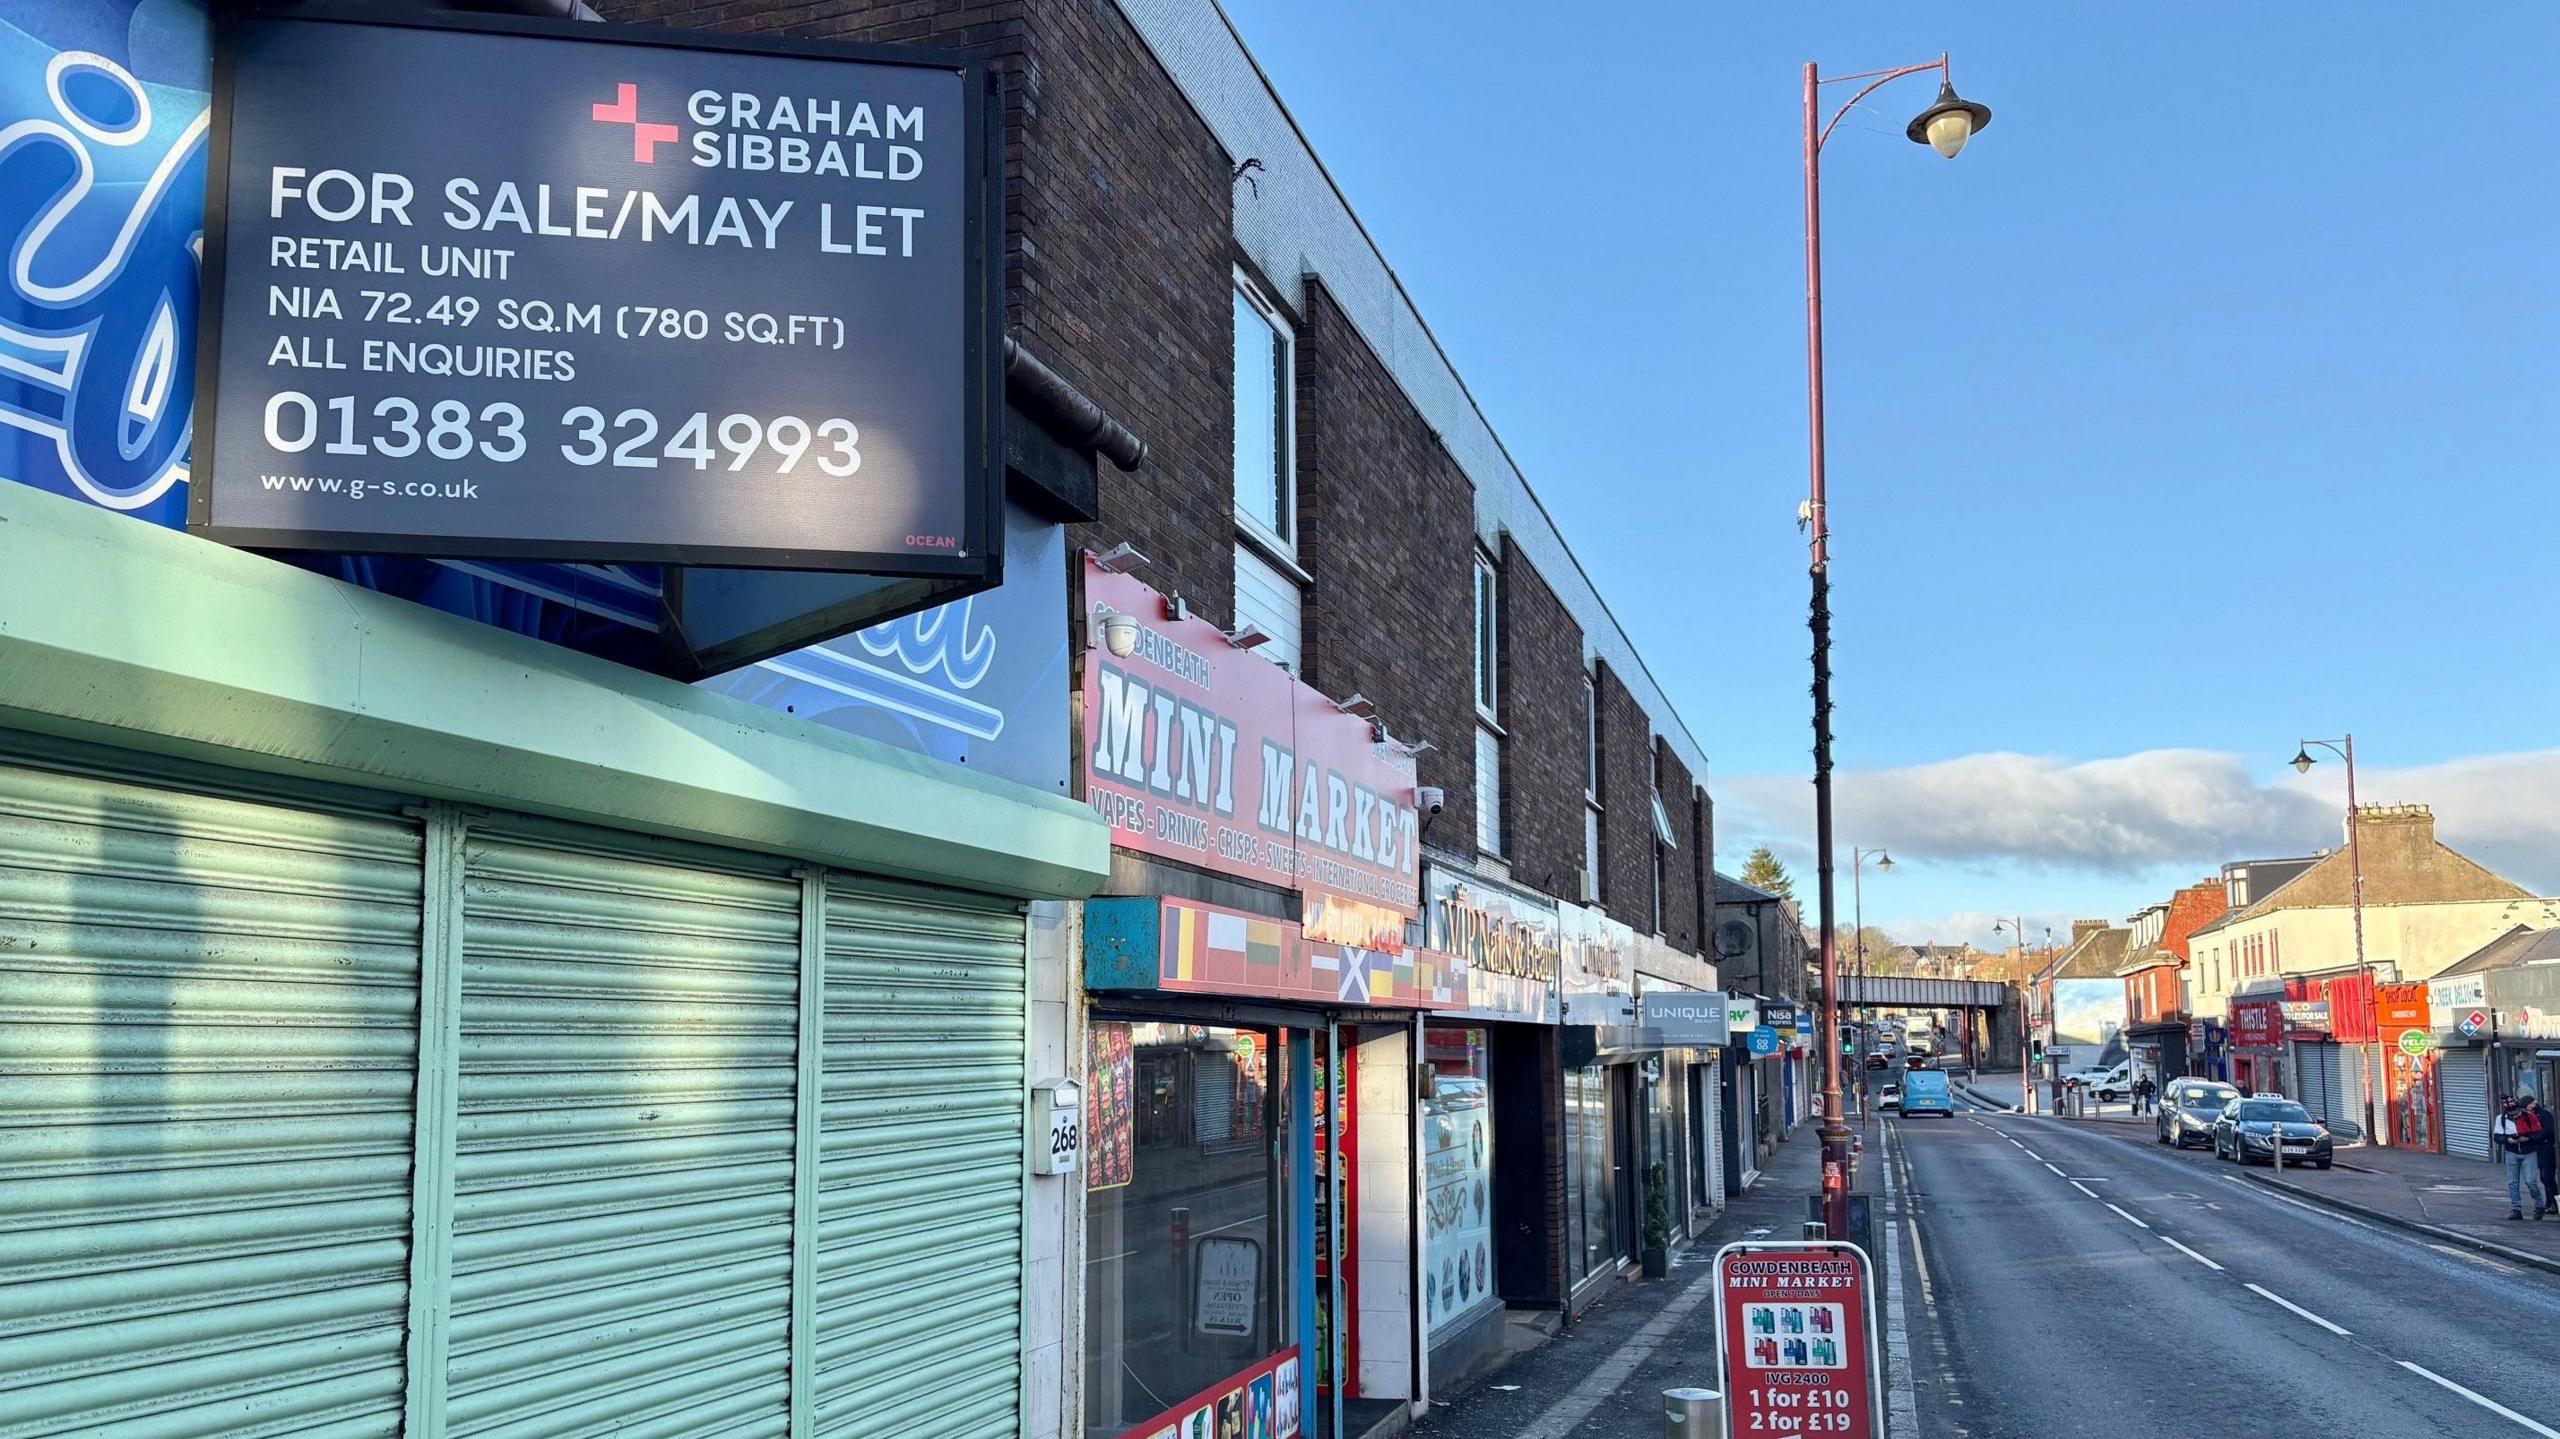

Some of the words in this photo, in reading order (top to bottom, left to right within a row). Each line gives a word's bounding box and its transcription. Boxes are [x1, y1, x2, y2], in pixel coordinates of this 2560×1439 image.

[686, 89, 924, 142] GRAHAM
[690, 130, 924, 181] SIBBALD
[270, 166, 414, 226] FOR
[443, 177, 795, 250] SALE/MAY
[820, 202, 925, 257] LET
[270, 236, 405, 277] RETAIL
[421, 244, 515, 281] UNIT
[269, 285, 344, 320] NIA
[360, 290, 480, 327] 72.49
[496, 298, 601, 335] SQ.M
[616, 305, 709, 342] (780
[723, 311, 845, 350] SQ.FT)
[267, 335, 346, 370] ALL
[363, 339, 576, 382] ENQUIRIES
[262, 390, 527, 463] 01383
[560, 404, 862, 477] 324993
[260, 472, 478, 500] www.g-s.co.uk
[905, 535, 956, 547] OCEAN
[1092, 600, 1210, 691] DENBEATH
[1094, 666, 1237, 815] MINI
[1258, 740, 1416, 876] MARKET
[1090, 786, 1145, 834] VAPES
[1156, 806, 1208, 852] DRINKS
[1217, 826, 1258, 865] CRISPS
[1265, 841, 1307, 878] SWEETS
[1313, 856, 1379, 899] INTERNATIONAL
[1651, 1007, 1721, 1020] UNIQUE
[1767, 1009, 1792, 1020] Nisa
[2240, 1008, 2268, 1030] THISTLE
[1051, 1125, 1077, 1154] 268
[1729, 1261, 1853, 1275] COWDENBEATH
[1729, 1277, 1768, 1288] MINI
[1776, 1276, 1854, 1288] MARKET
[1763, 1290, 1788, 1298] OPEN
[1796, 1290, 1821, 1298] DAYS
[1765, 1373, 1791, 1385] IVG
[1794, 1373, 1829, 1384] 2400
[1750, 1390, 1760, 1407] 1
[1767, 1388, 1801, 1407] for
[1807, 1390, 1849, 1408] £10
[1750, 1413, 1763, 1430] 2
[1768, 1411, 1802, 1430] for
[1808, 1413, 1850, 1431] £19
